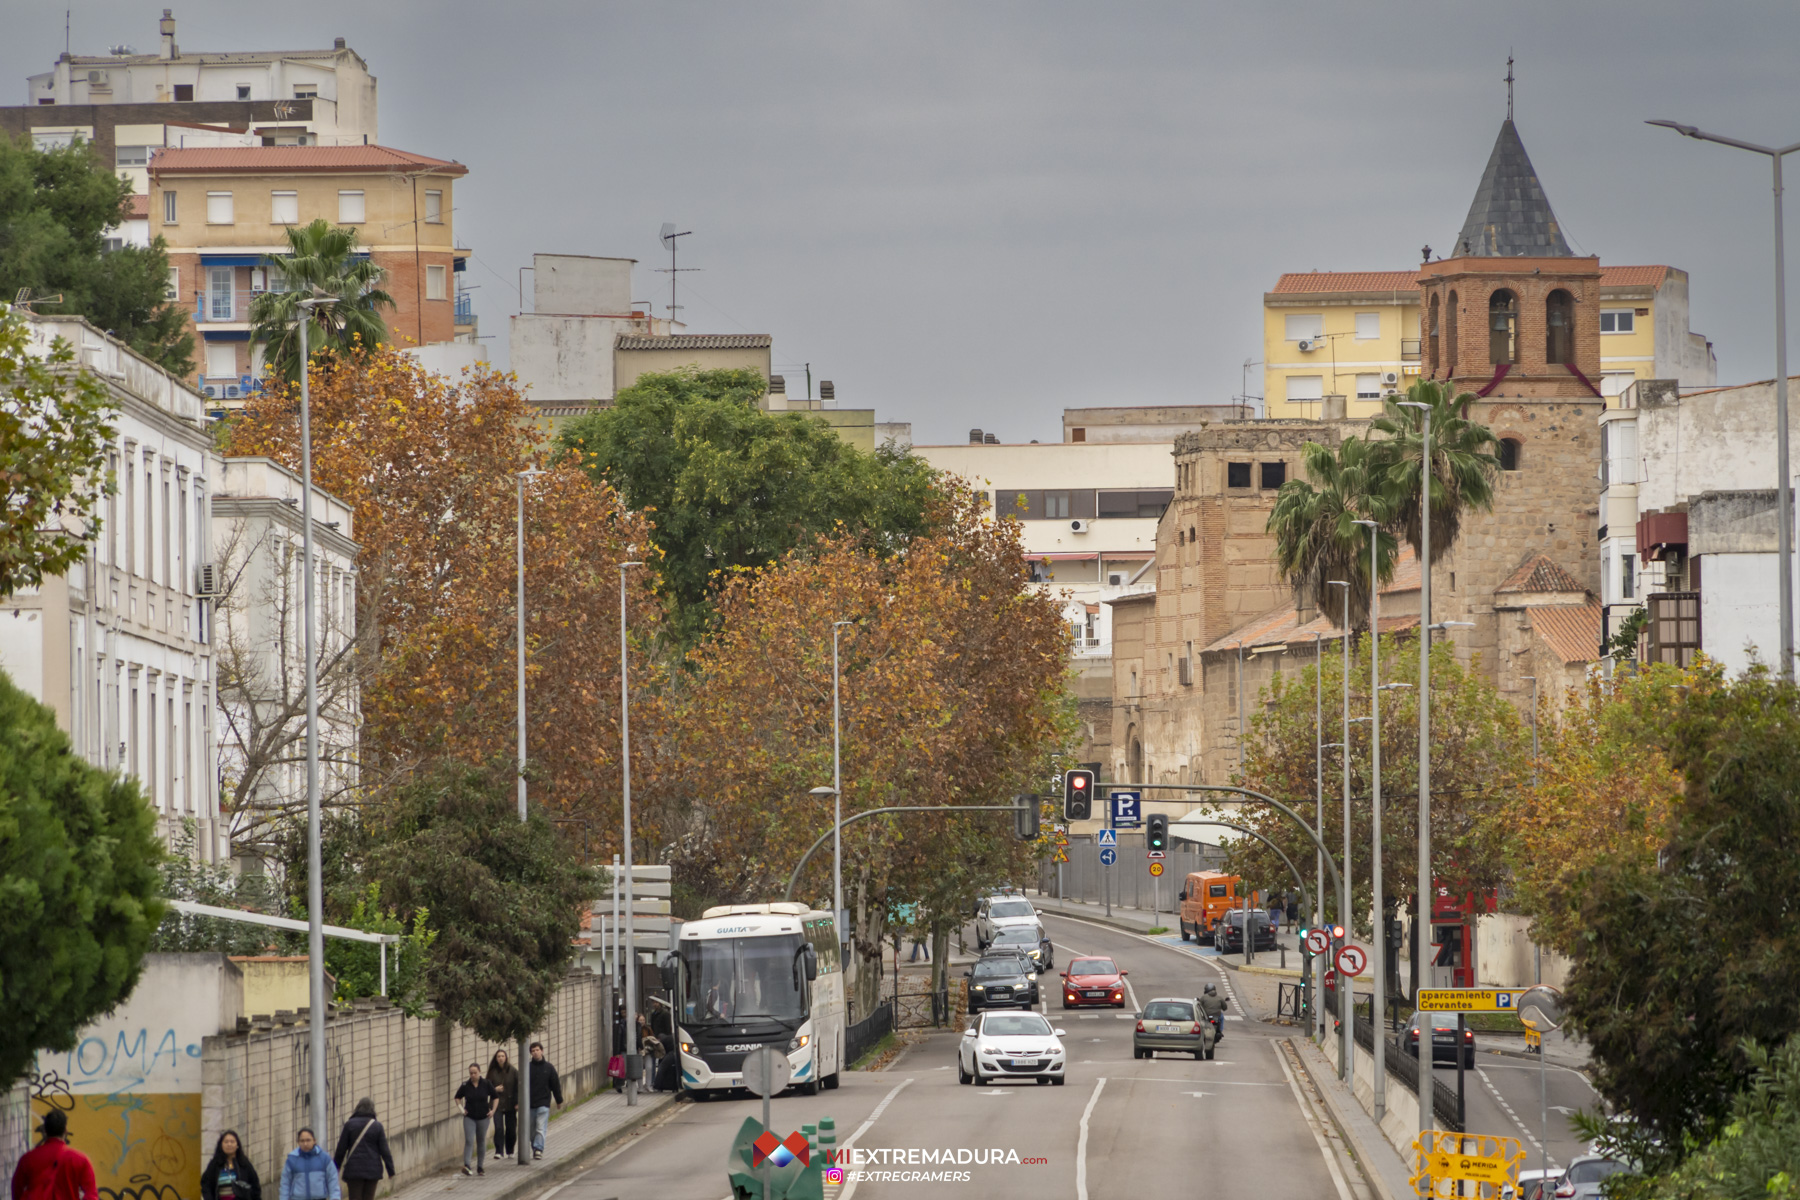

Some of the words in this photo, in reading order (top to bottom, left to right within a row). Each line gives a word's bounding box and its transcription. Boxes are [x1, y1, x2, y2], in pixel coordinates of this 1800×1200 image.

[1117, 794, 1135, 816] P
[716, 926, 747, 935] GUAITA
[1421, 990, 1492, 1000] aparcamiento
[1421, 1000, 1473, 1009] Cervantes
[725, 1043, 763, 1053] SCANIA
